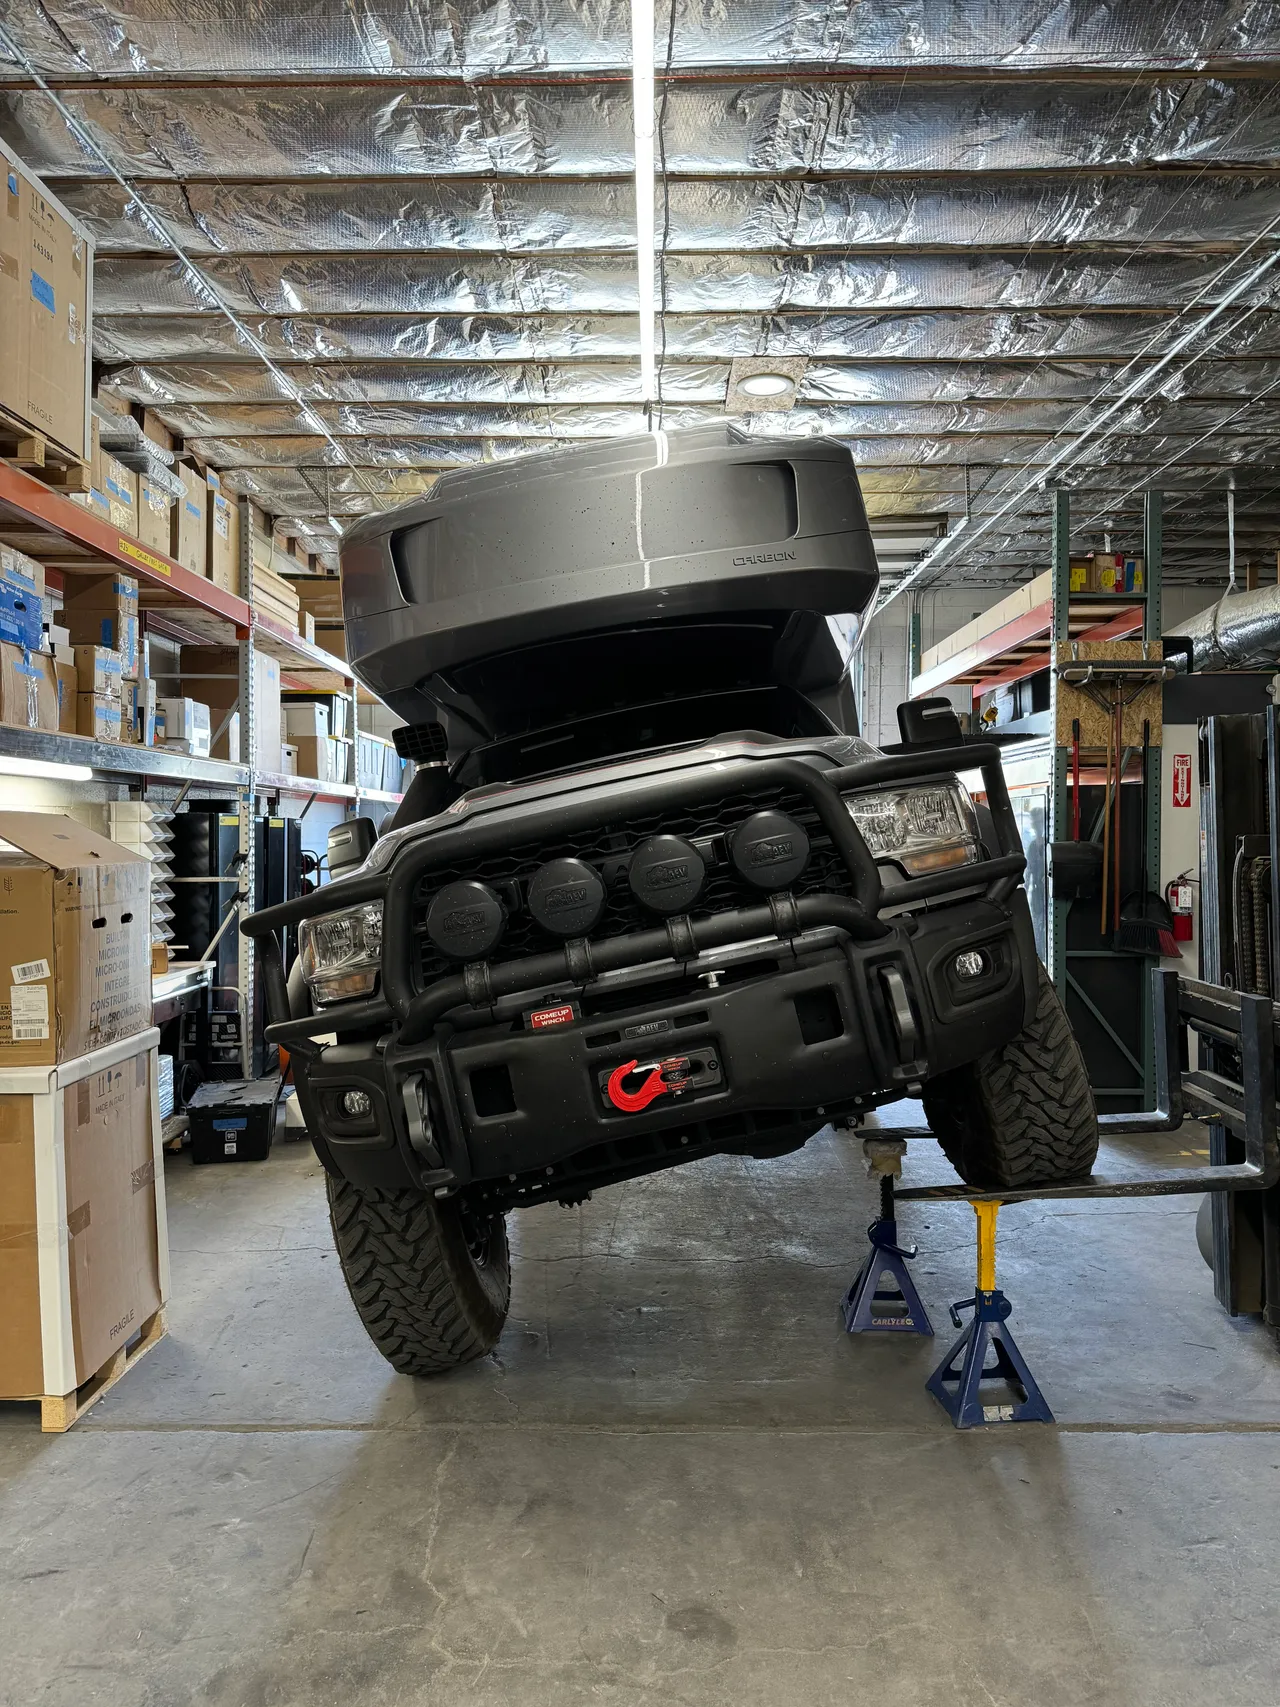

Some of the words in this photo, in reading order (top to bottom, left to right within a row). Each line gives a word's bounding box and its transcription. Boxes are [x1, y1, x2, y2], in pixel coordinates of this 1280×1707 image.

[27, 400, 53, 425] FRAGILE
[732, 550, 797, 566] CARBON
[1177, 759, 1189, 767] FIRE
[90, 992, 132, 1013] CONSTRUIDO
[534, 1009, 569, 1021] COMEUP
[541, 1017, 561, 1026] WINCH
[96, 1101, 109, 1114] MADE
[114, 1093, 125, 1105] ITALY
[109, 1308, 135, 1341] FRAGILE
[872, 1318, 905, 1326] CARLYLE
